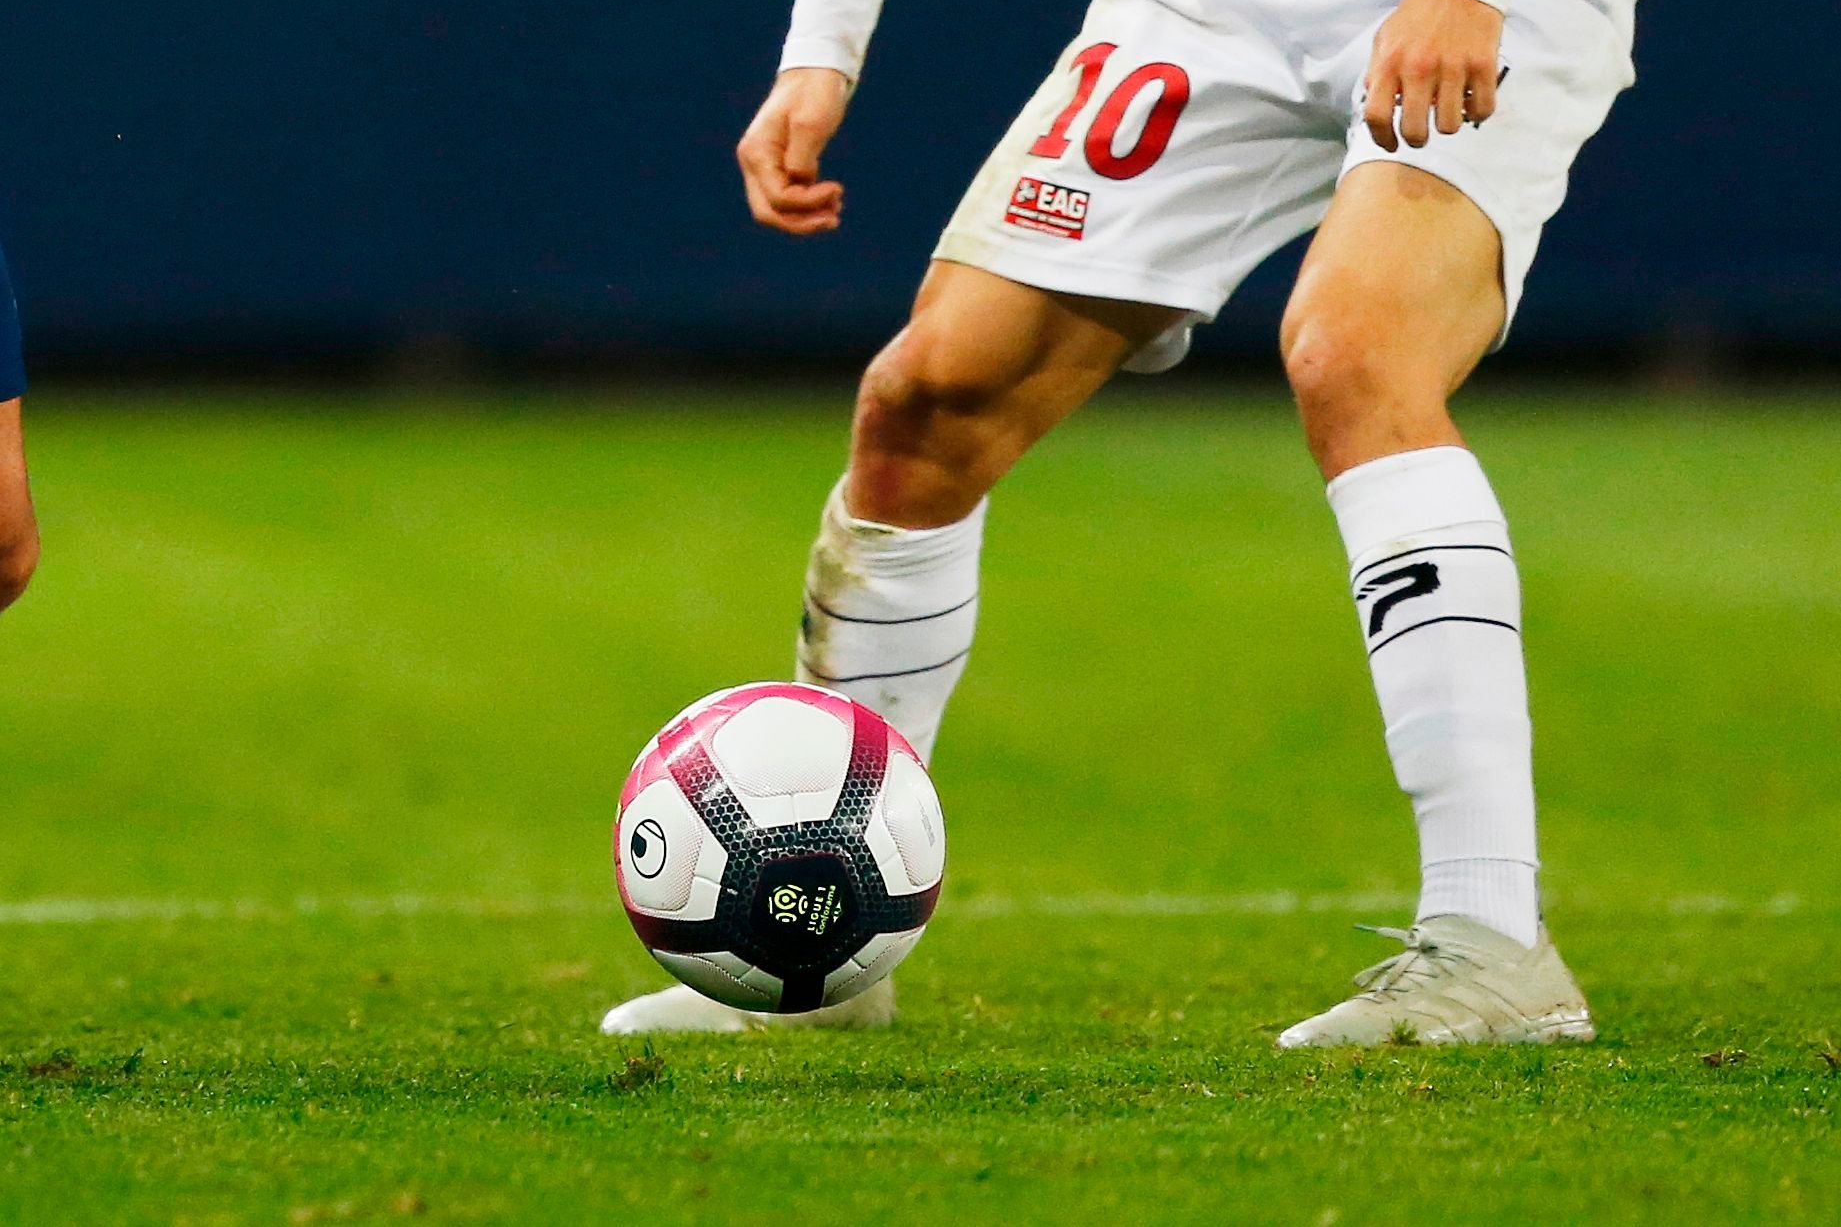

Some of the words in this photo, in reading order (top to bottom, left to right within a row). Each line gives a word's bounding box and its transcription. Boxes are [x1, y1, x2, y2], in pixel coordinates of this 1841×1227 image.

[1027, 41, 1191, 181] 10
[1037, 183, 1088, 220] EAG
[807, 896, 824, 931] LIGUE
[815, 884, 837, 935] Conforama
